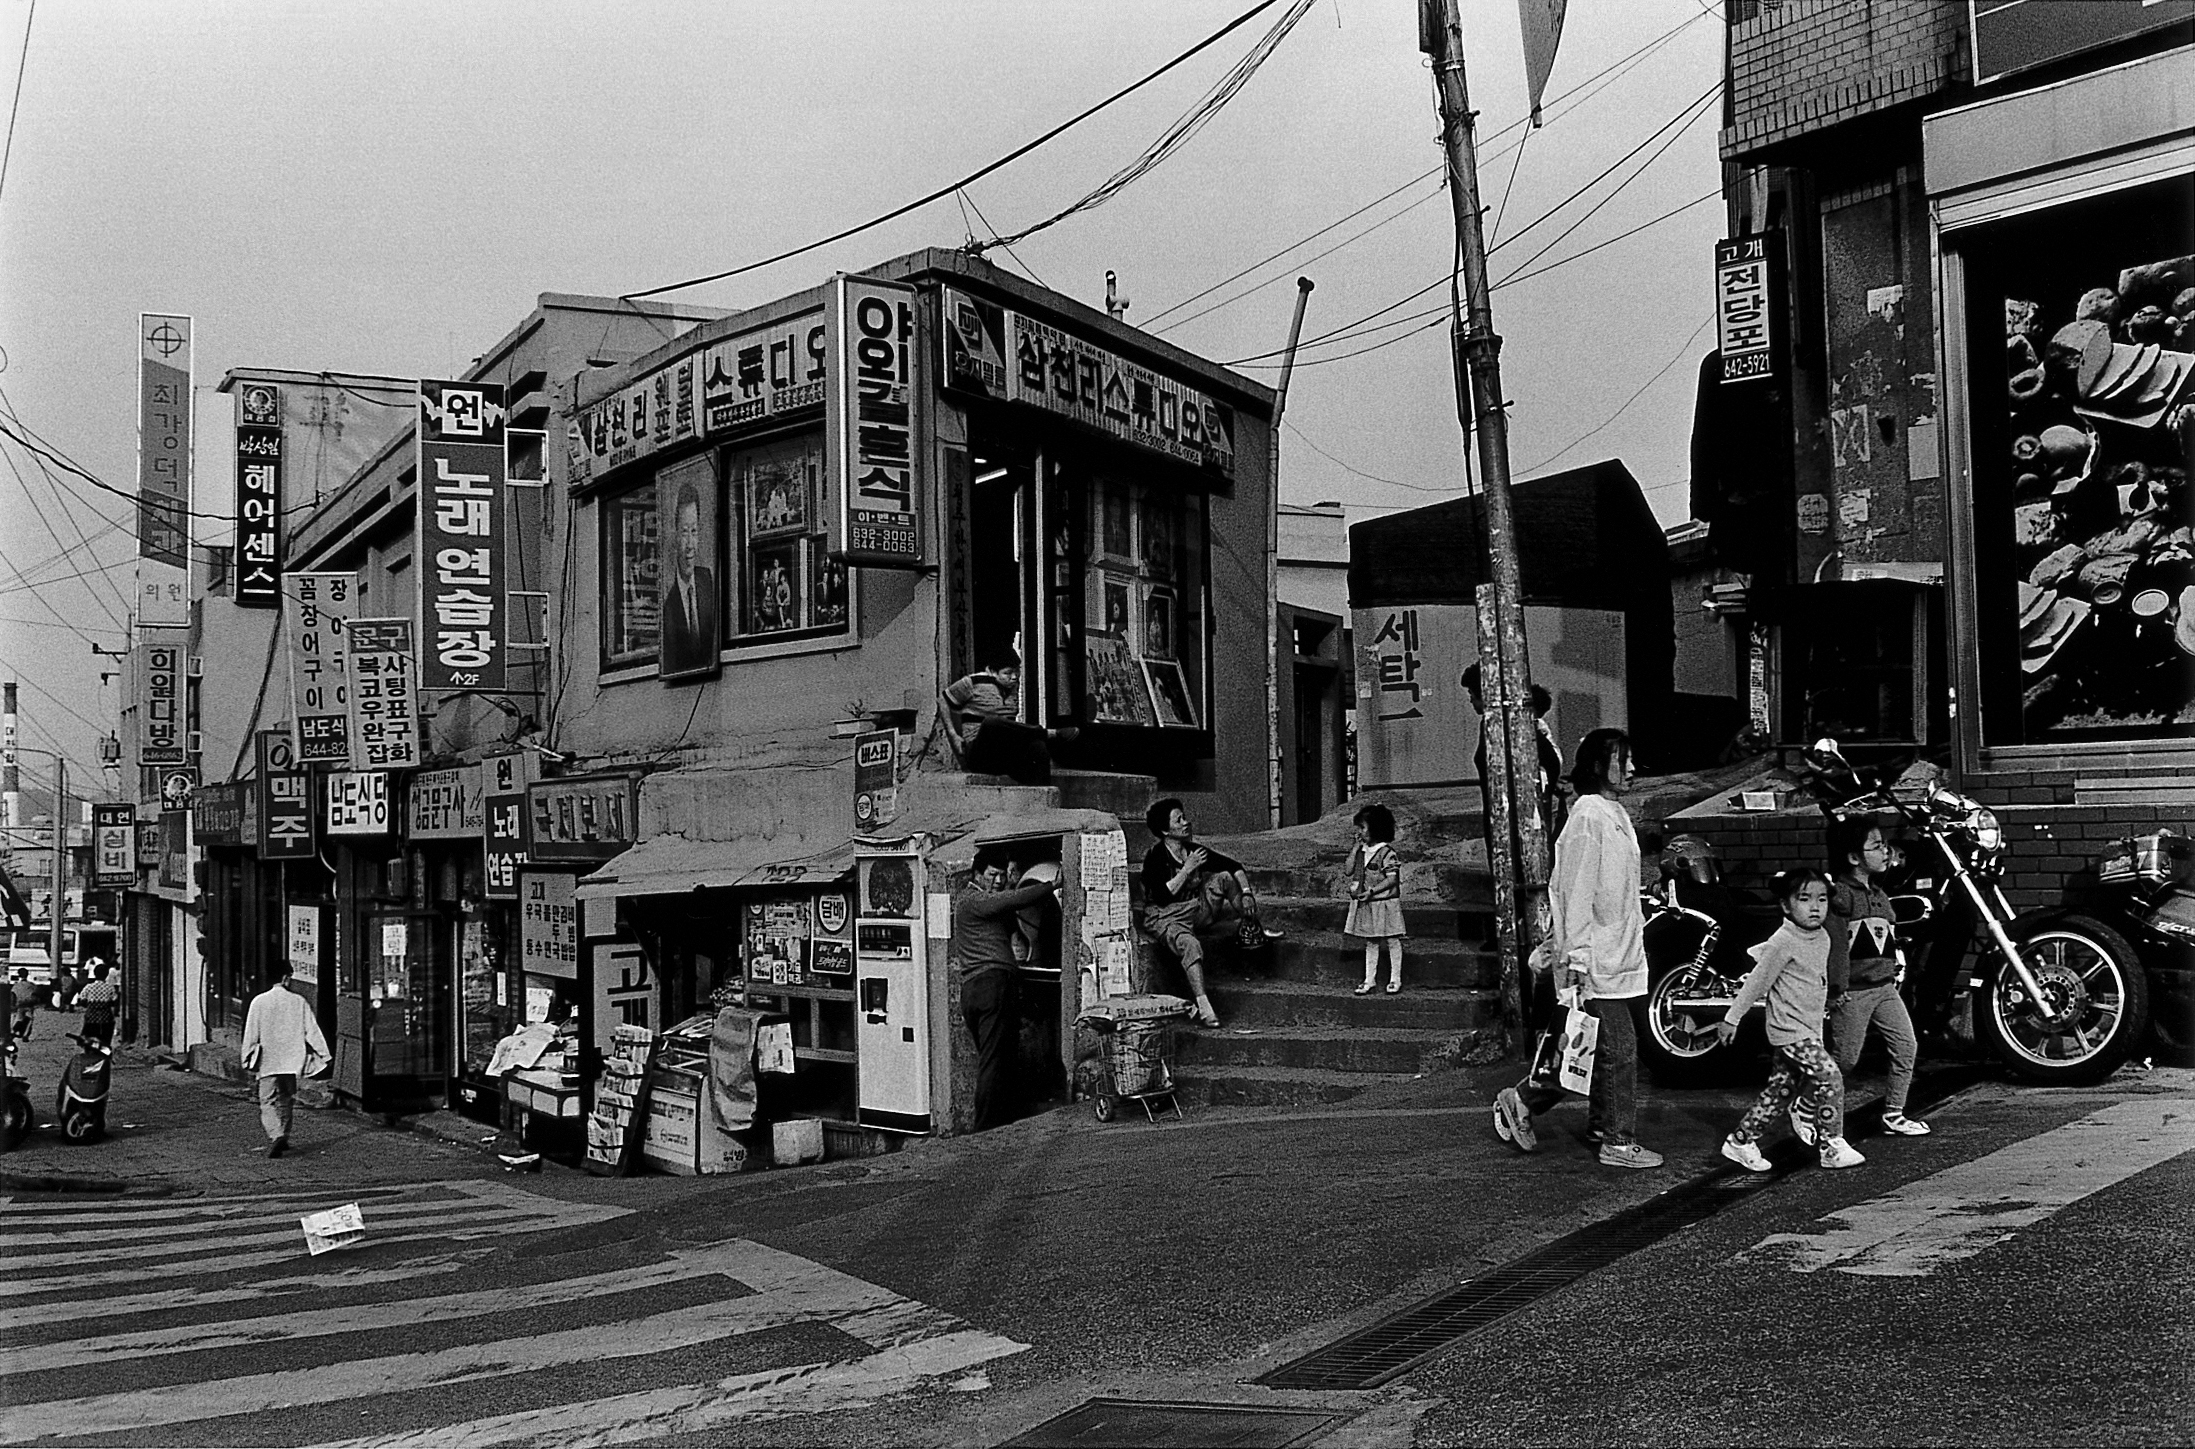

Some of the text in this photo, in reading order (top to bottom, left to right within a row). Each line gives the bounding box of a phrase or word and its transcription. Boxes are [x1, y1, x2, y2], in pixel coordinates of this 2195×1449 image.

[1720, 238, 1763, 264] 고개
[1723, 265, 1767, 352] 전당포
[1724, 353, 1770, 378] 642-5921
[446, 393, 479, 432] 원
[857, 296, 913, 511] 야외결혼식
[594, 390, 648, 457] 삼천리
[153, 384, 182, 493] 최강덕
[243, 465, 275, 594] 헤어센스
[853, 527, 915, 542] 632-3002
[853, 537, 915, 553] 644-0063
[435, 458, 496, 667] 노래 연습장
[145, 583, 181, 601] 의원
[299, 578, 322, 710] 꼼장어구이
[354, 626, 407, 649] 문구
[357, 656, 407, 675] 복사
[1374, 610, 1421, 702] 세탁
[358, 677, 406, 698] 코팅
[464, 673, 480, 685] 2F
[150, 648, 177, 747] 희원다방
[360, 699, 410, 720] 우표
[362, 721, 412, 742] 완구
[366, 742, 414, 764] 잡화
[861, 743, 889, 764] 버스표
[497, 758, 513, 790] 원
[269, 776, 309, 847] 맥주
[332, 774, 387, 826] 남도식당
[100, 811, 130, 824] 대연
[493, 804, 520, 839] 노래
[104, 829, 126, 869] 실비
[822, 900, 844, 920] 담배
